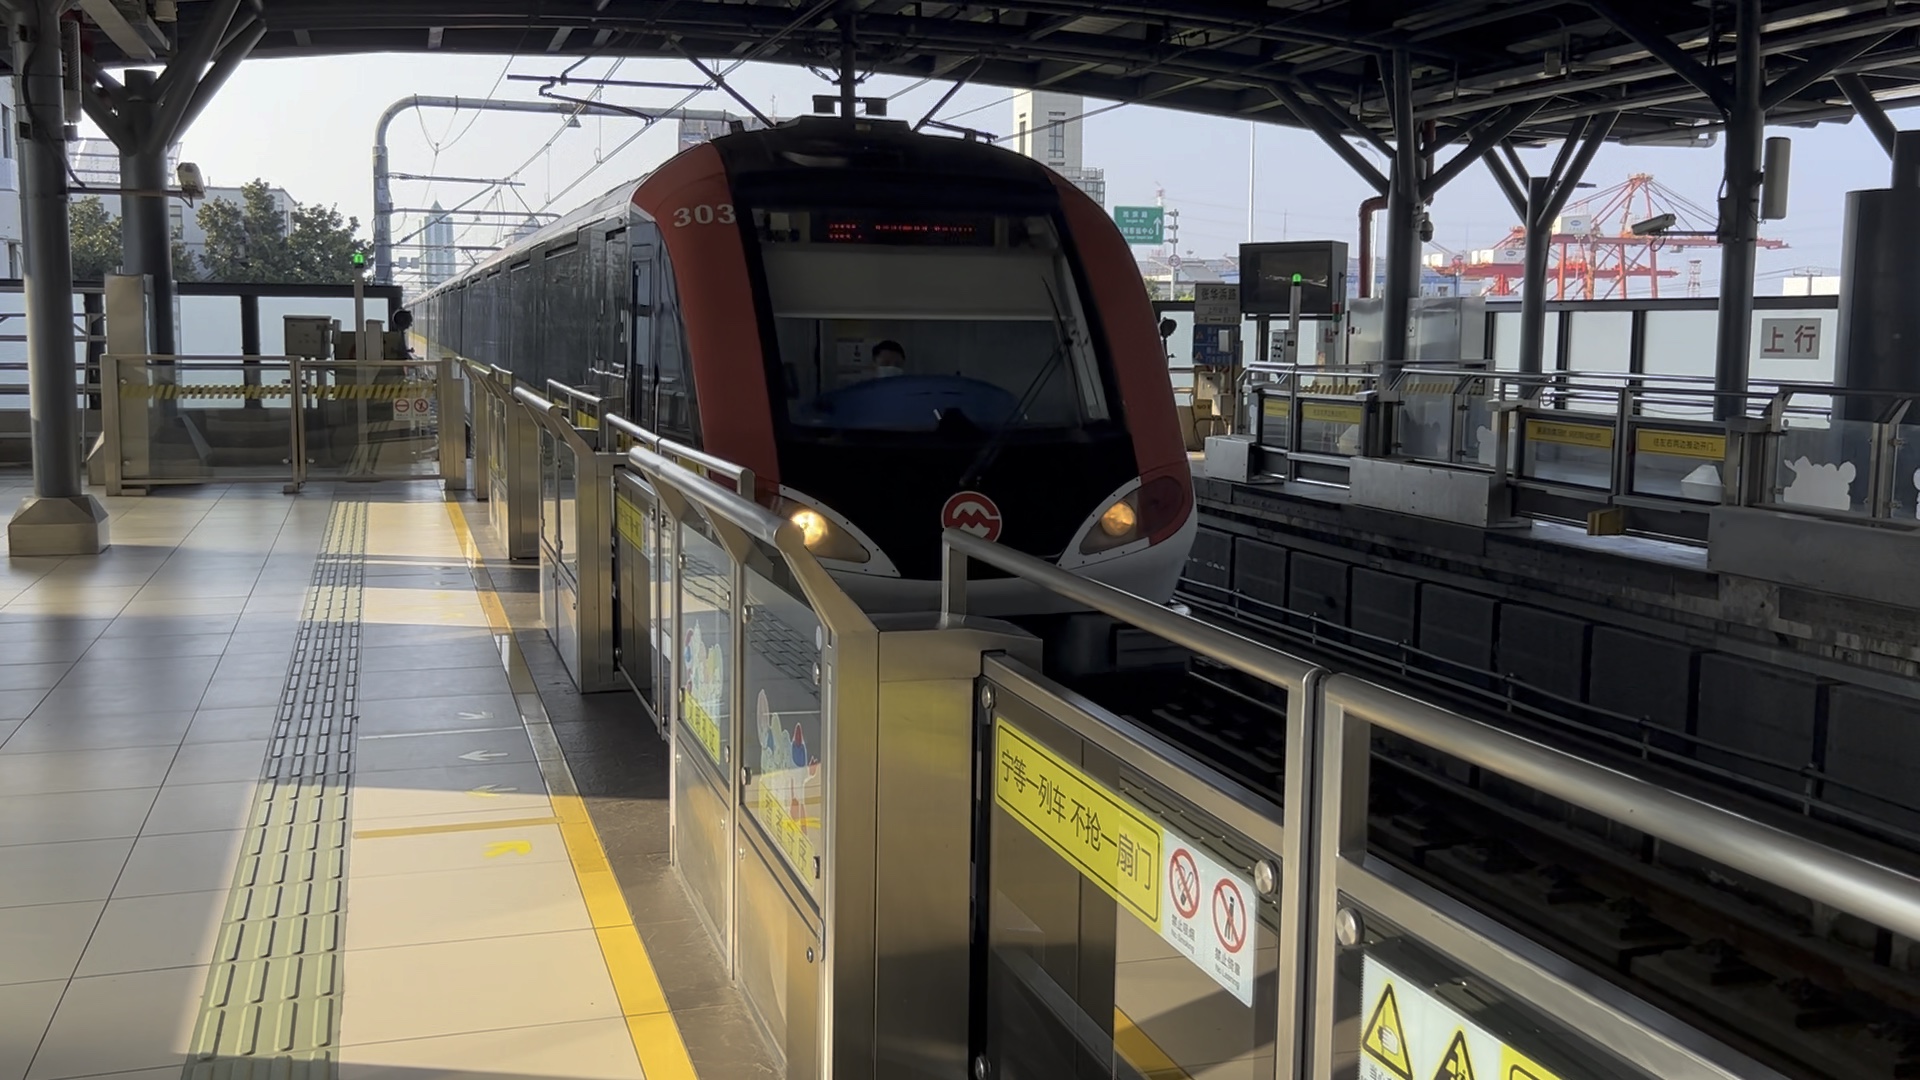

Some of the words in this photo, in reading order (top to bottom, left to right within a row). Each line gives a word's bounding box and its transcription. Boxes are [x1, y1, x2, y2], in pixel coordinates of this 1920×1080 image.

[673, 204, 736, 228] 303
[1763, 325, 1816, 353] 上行
[1001, 749, 1067, 824] 宁等一列车
[1070, 798, 1152, 891] 不抢一扇门
